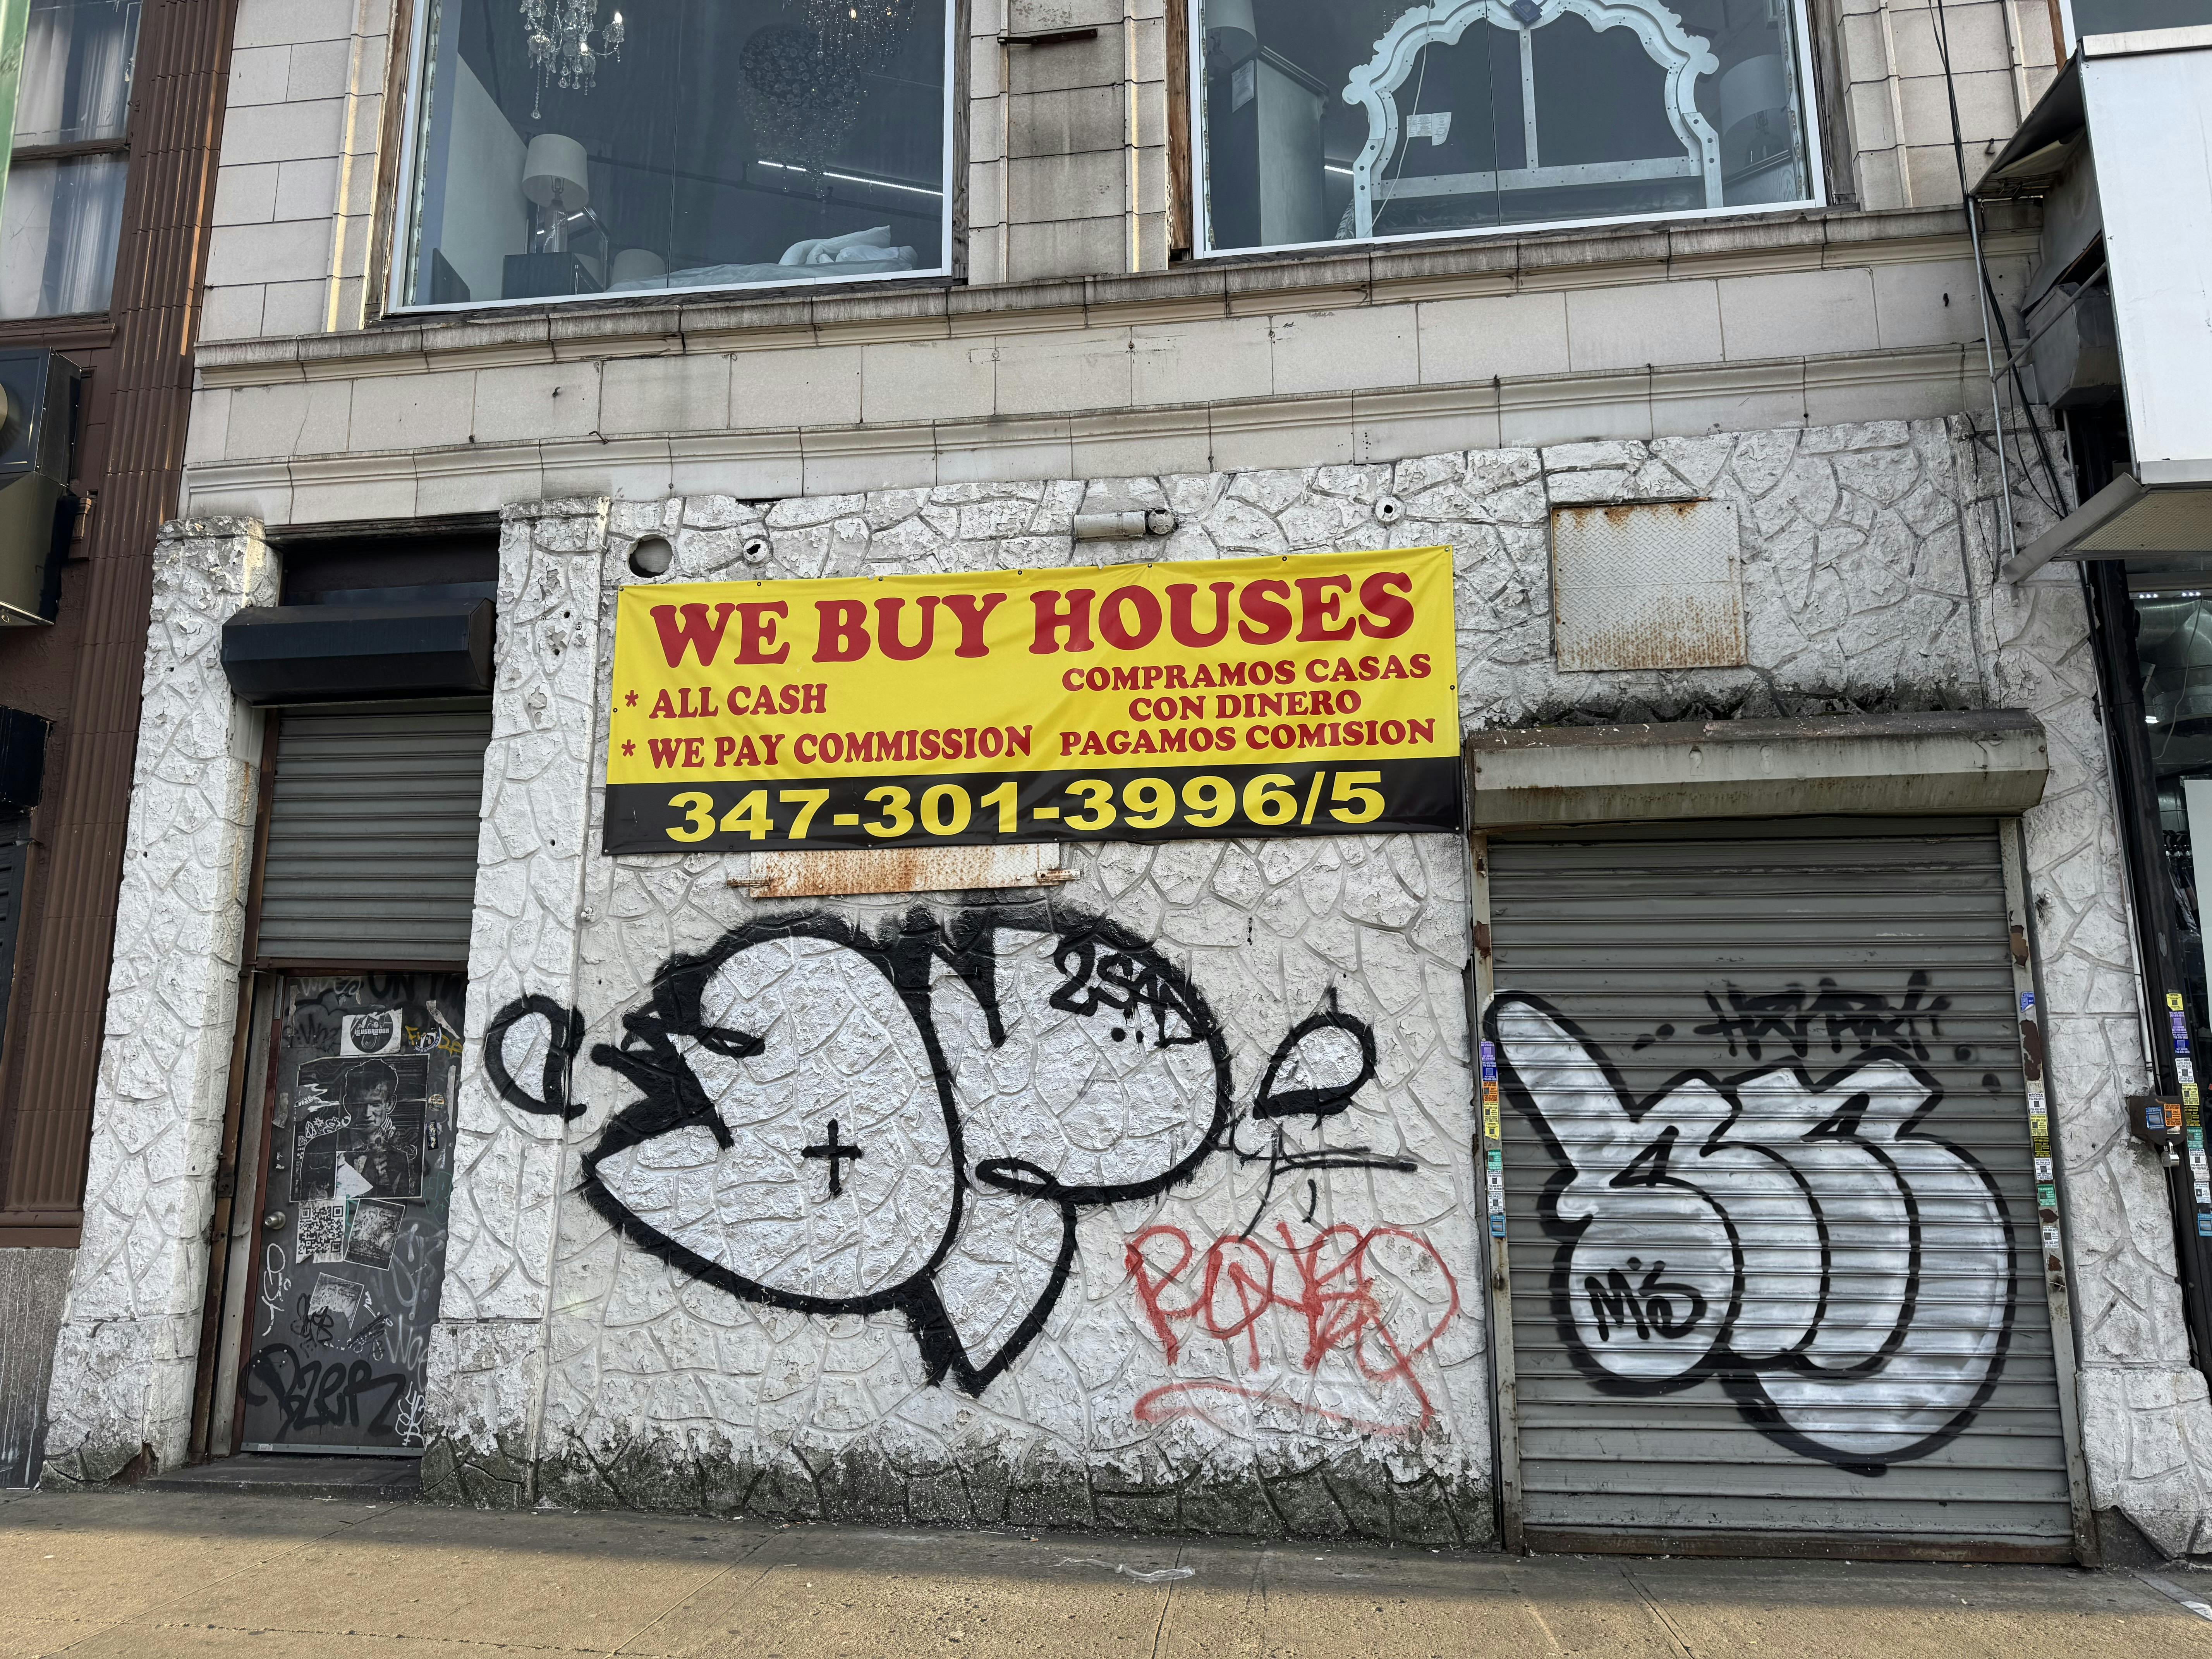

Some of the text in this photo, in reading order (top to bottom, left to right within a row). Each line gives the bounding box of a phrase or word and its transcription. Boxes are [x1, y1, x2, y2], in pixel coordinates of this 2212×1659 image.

[650, 572, 1415, 668] WE BUY HOUSES
[1062, 653, 1432, 692] COMPRAMOS CASAS
[649, 683, 828, 719] ALL CASH
[1128, 689, 1362, 722] CON DINERO
[647, 725, 1033, 769] WE PAY COMMISSION
[1059, 718, 1436, 756] PAGAMOS COMISION
[666, 771, 1385, 843] 347-301-3996/5
